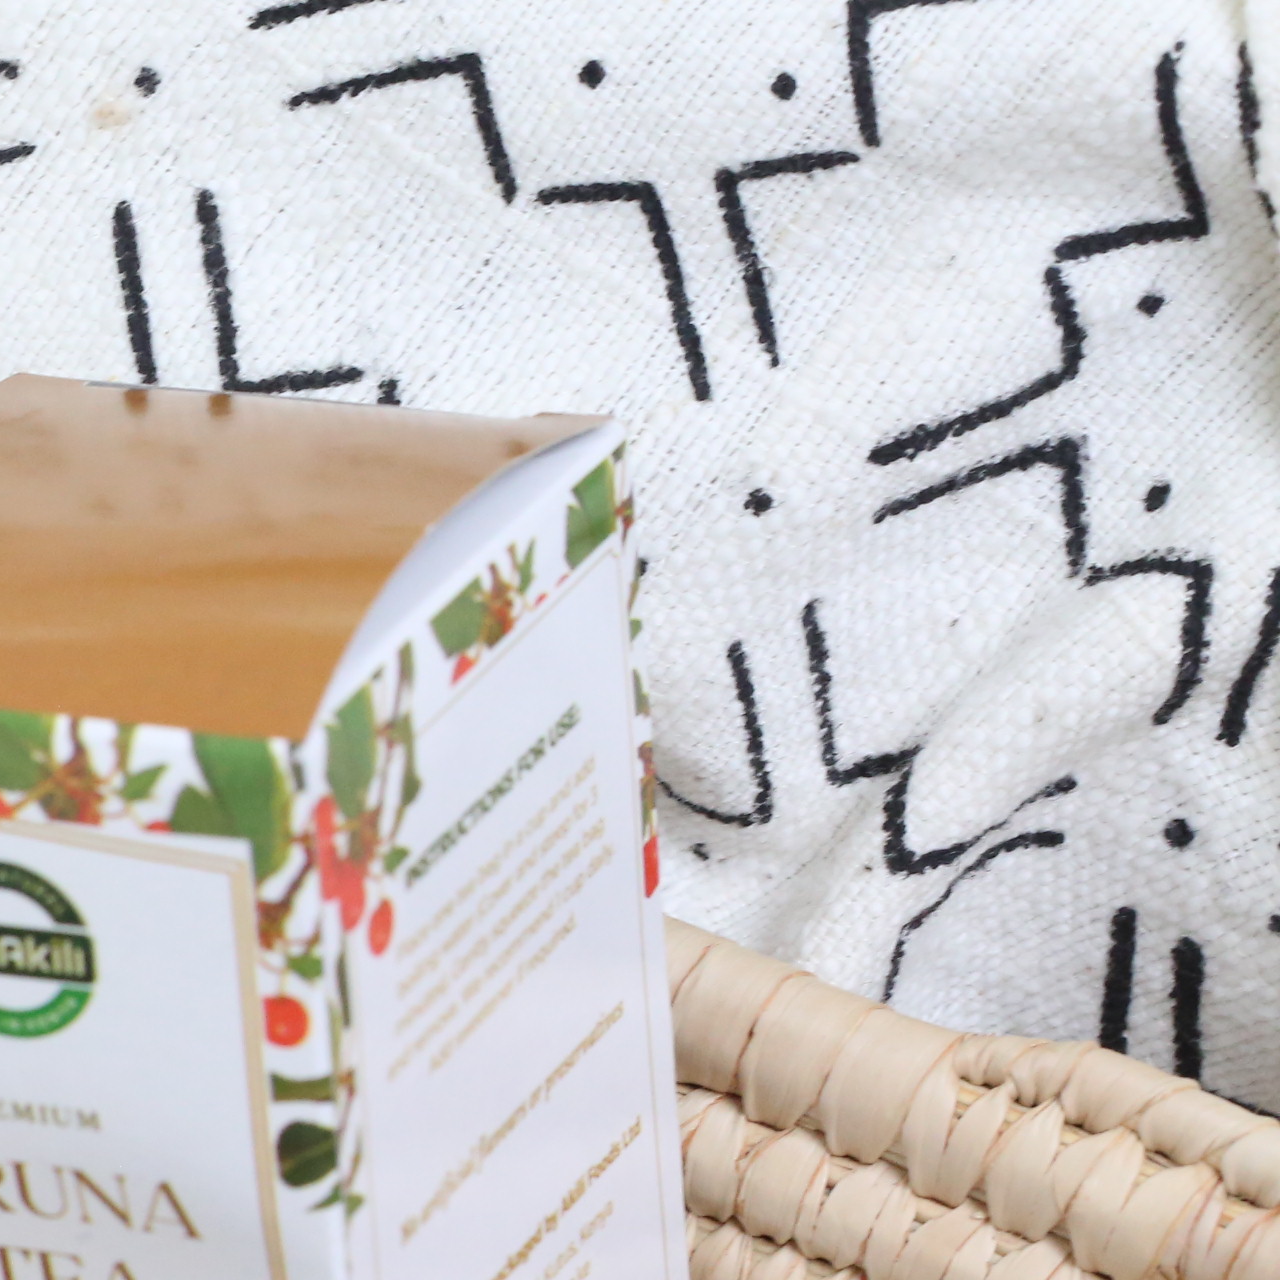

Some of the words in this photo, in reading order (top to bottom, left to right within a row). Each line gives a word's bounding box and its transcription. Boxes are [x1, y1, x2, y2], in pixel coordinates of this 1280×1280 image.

[517, 736, 548, 778] FOR
[560, 1176, 588, 1215] Akili
[586, 1141, 622, 1185] Foods
